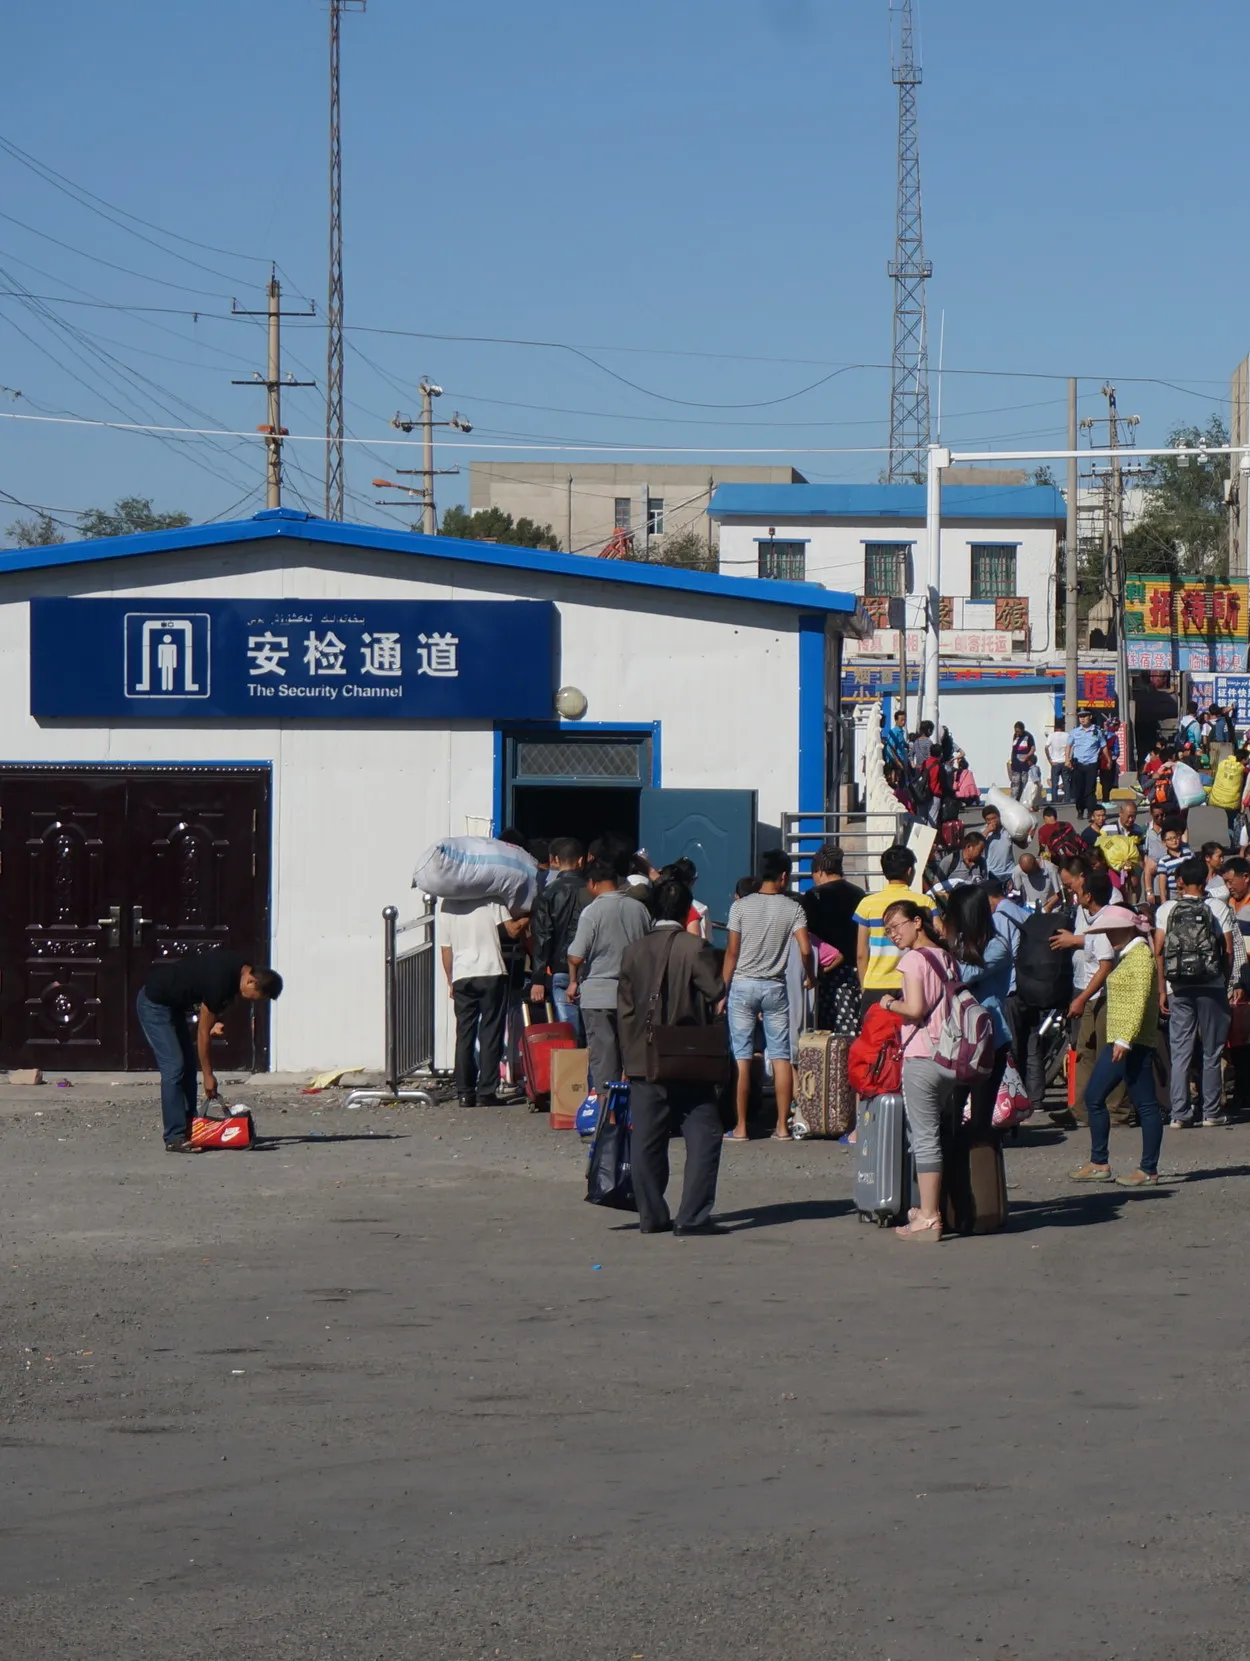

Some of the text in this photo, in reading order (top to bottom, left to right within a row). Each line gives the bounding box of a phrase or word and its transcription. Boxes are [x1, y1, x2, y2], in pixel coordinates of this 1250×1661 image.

[1149, 588, 1241, 630] 招待所
[247, 631, 459, 677] 安检通道
[247, 684, 403, 700] The Security Channel
